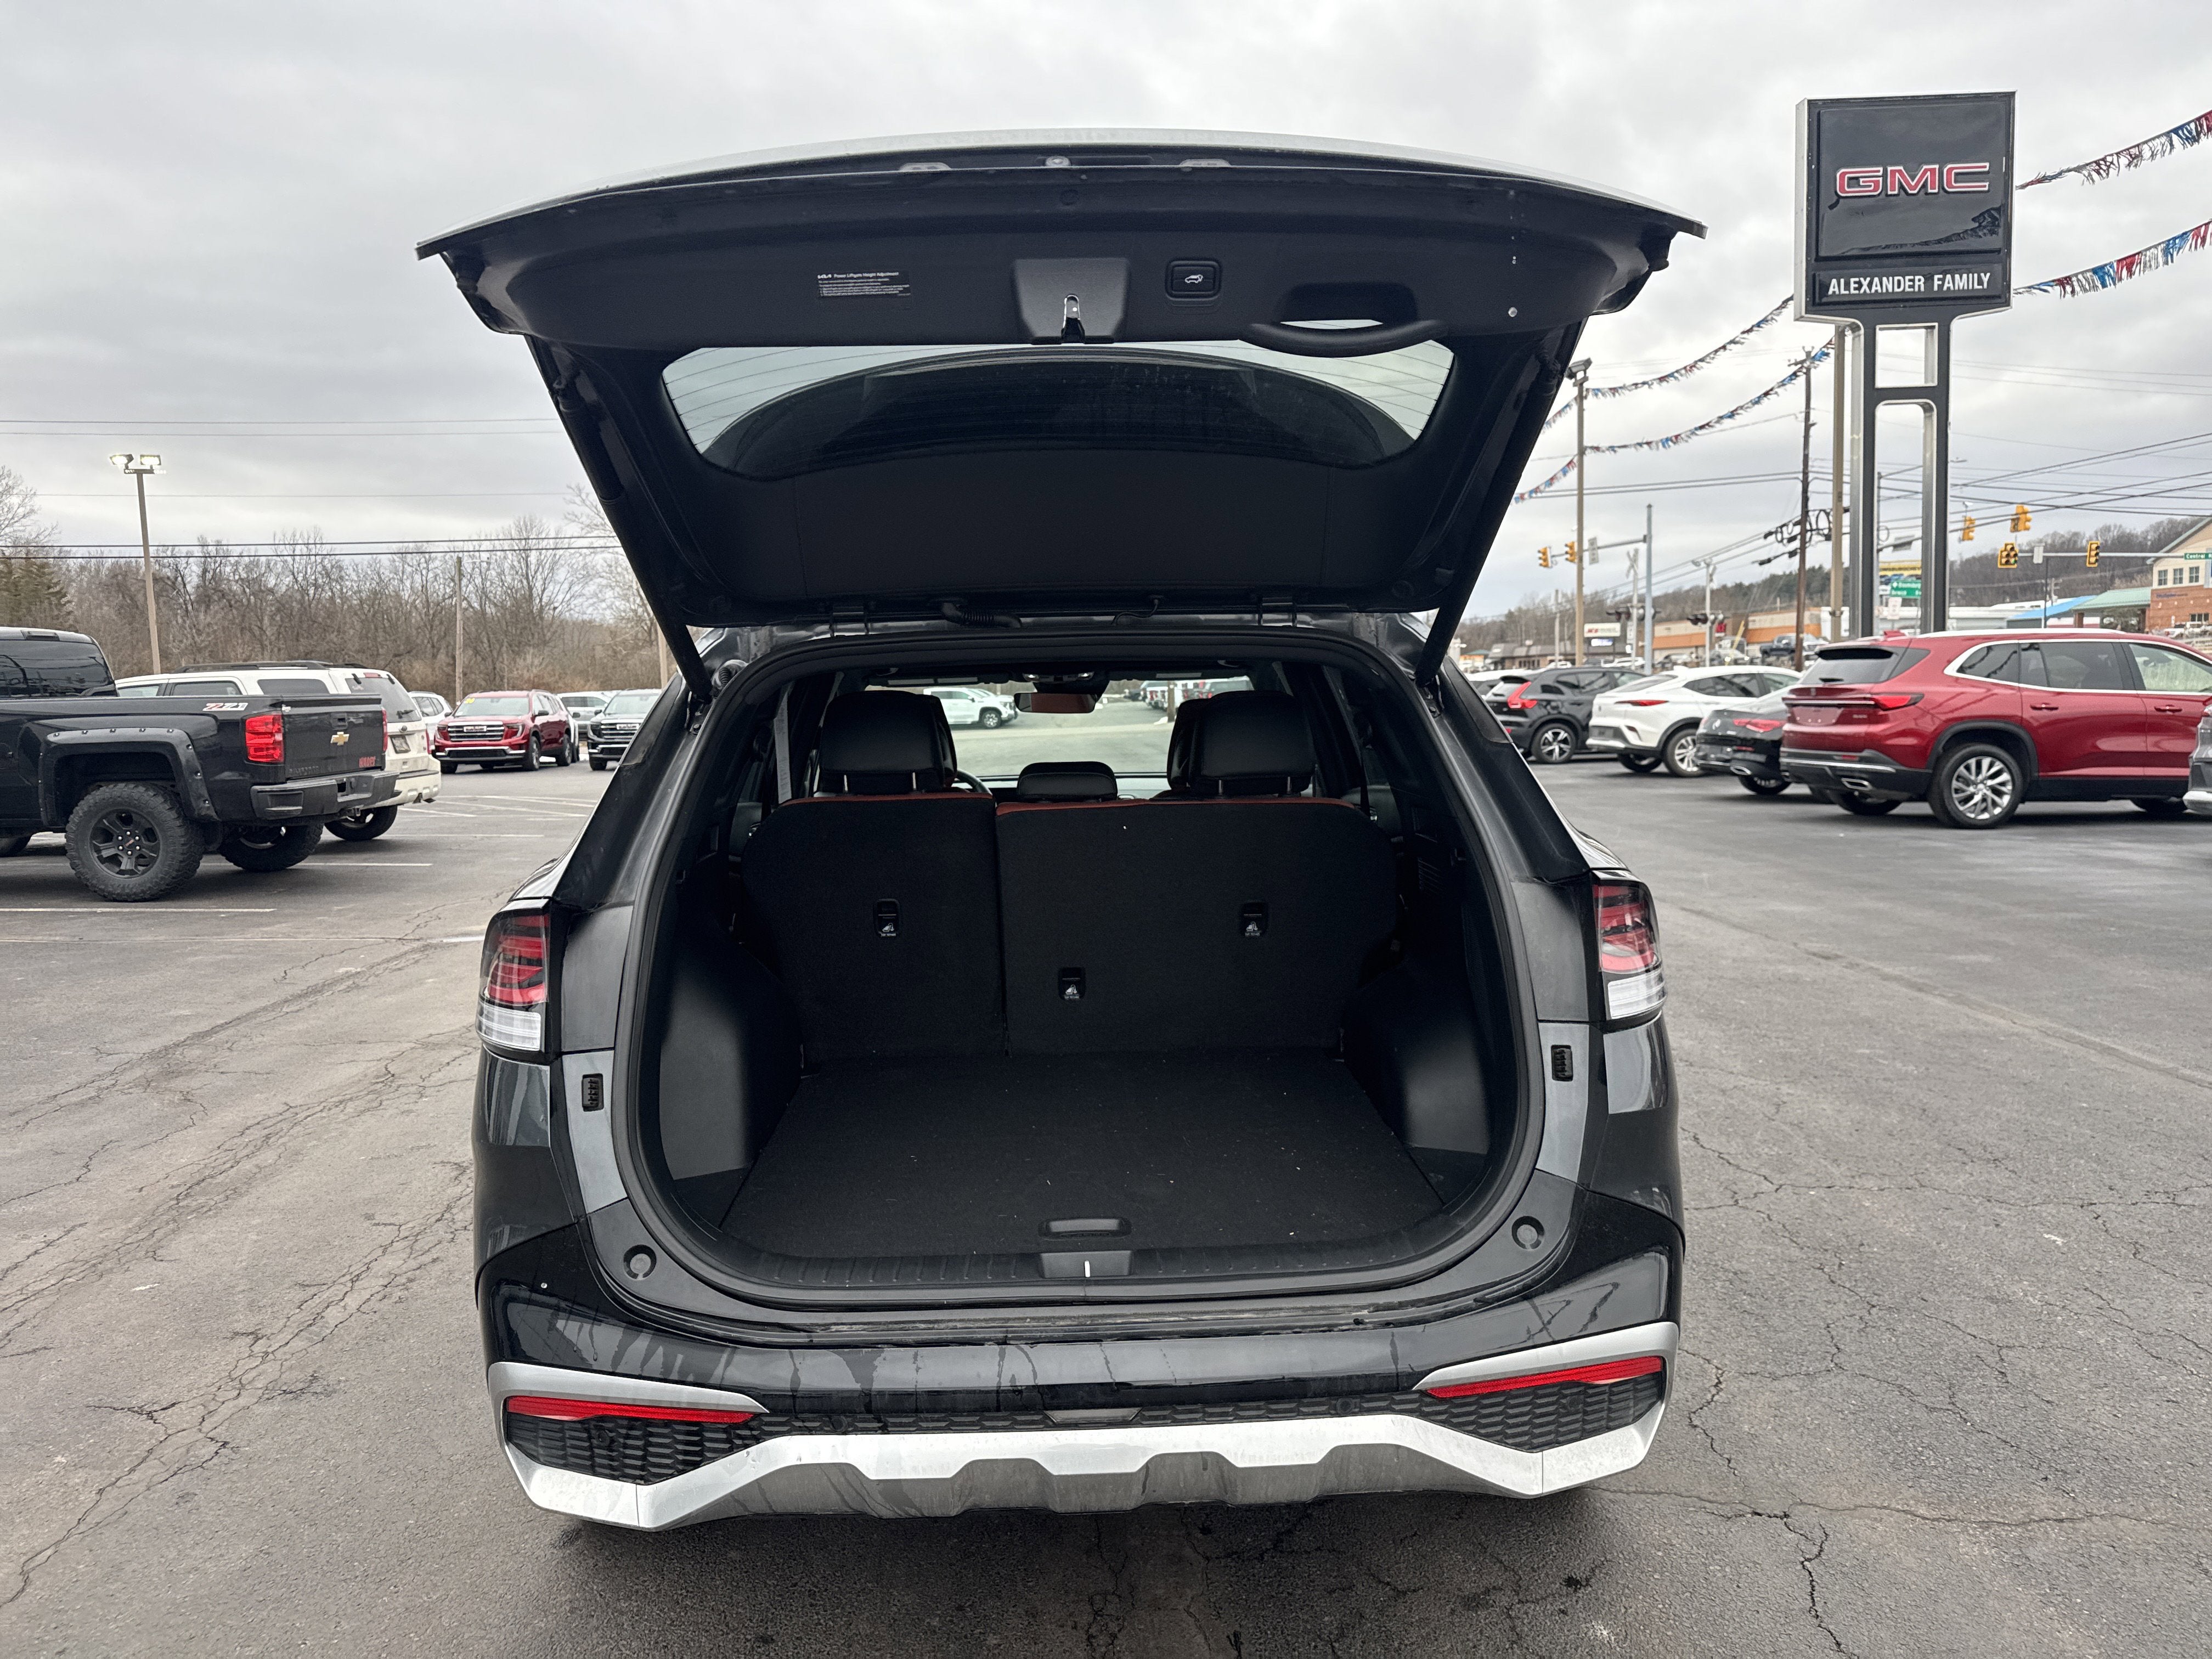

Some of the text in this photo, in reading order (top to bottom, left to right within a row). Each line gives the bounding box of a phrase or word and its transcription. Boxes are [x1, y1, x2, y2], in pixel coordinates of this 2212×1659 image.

[1836, 162, 1990, 196] GMC
[1828, 273, 1991, 295] ALEXANDER FAMILY
